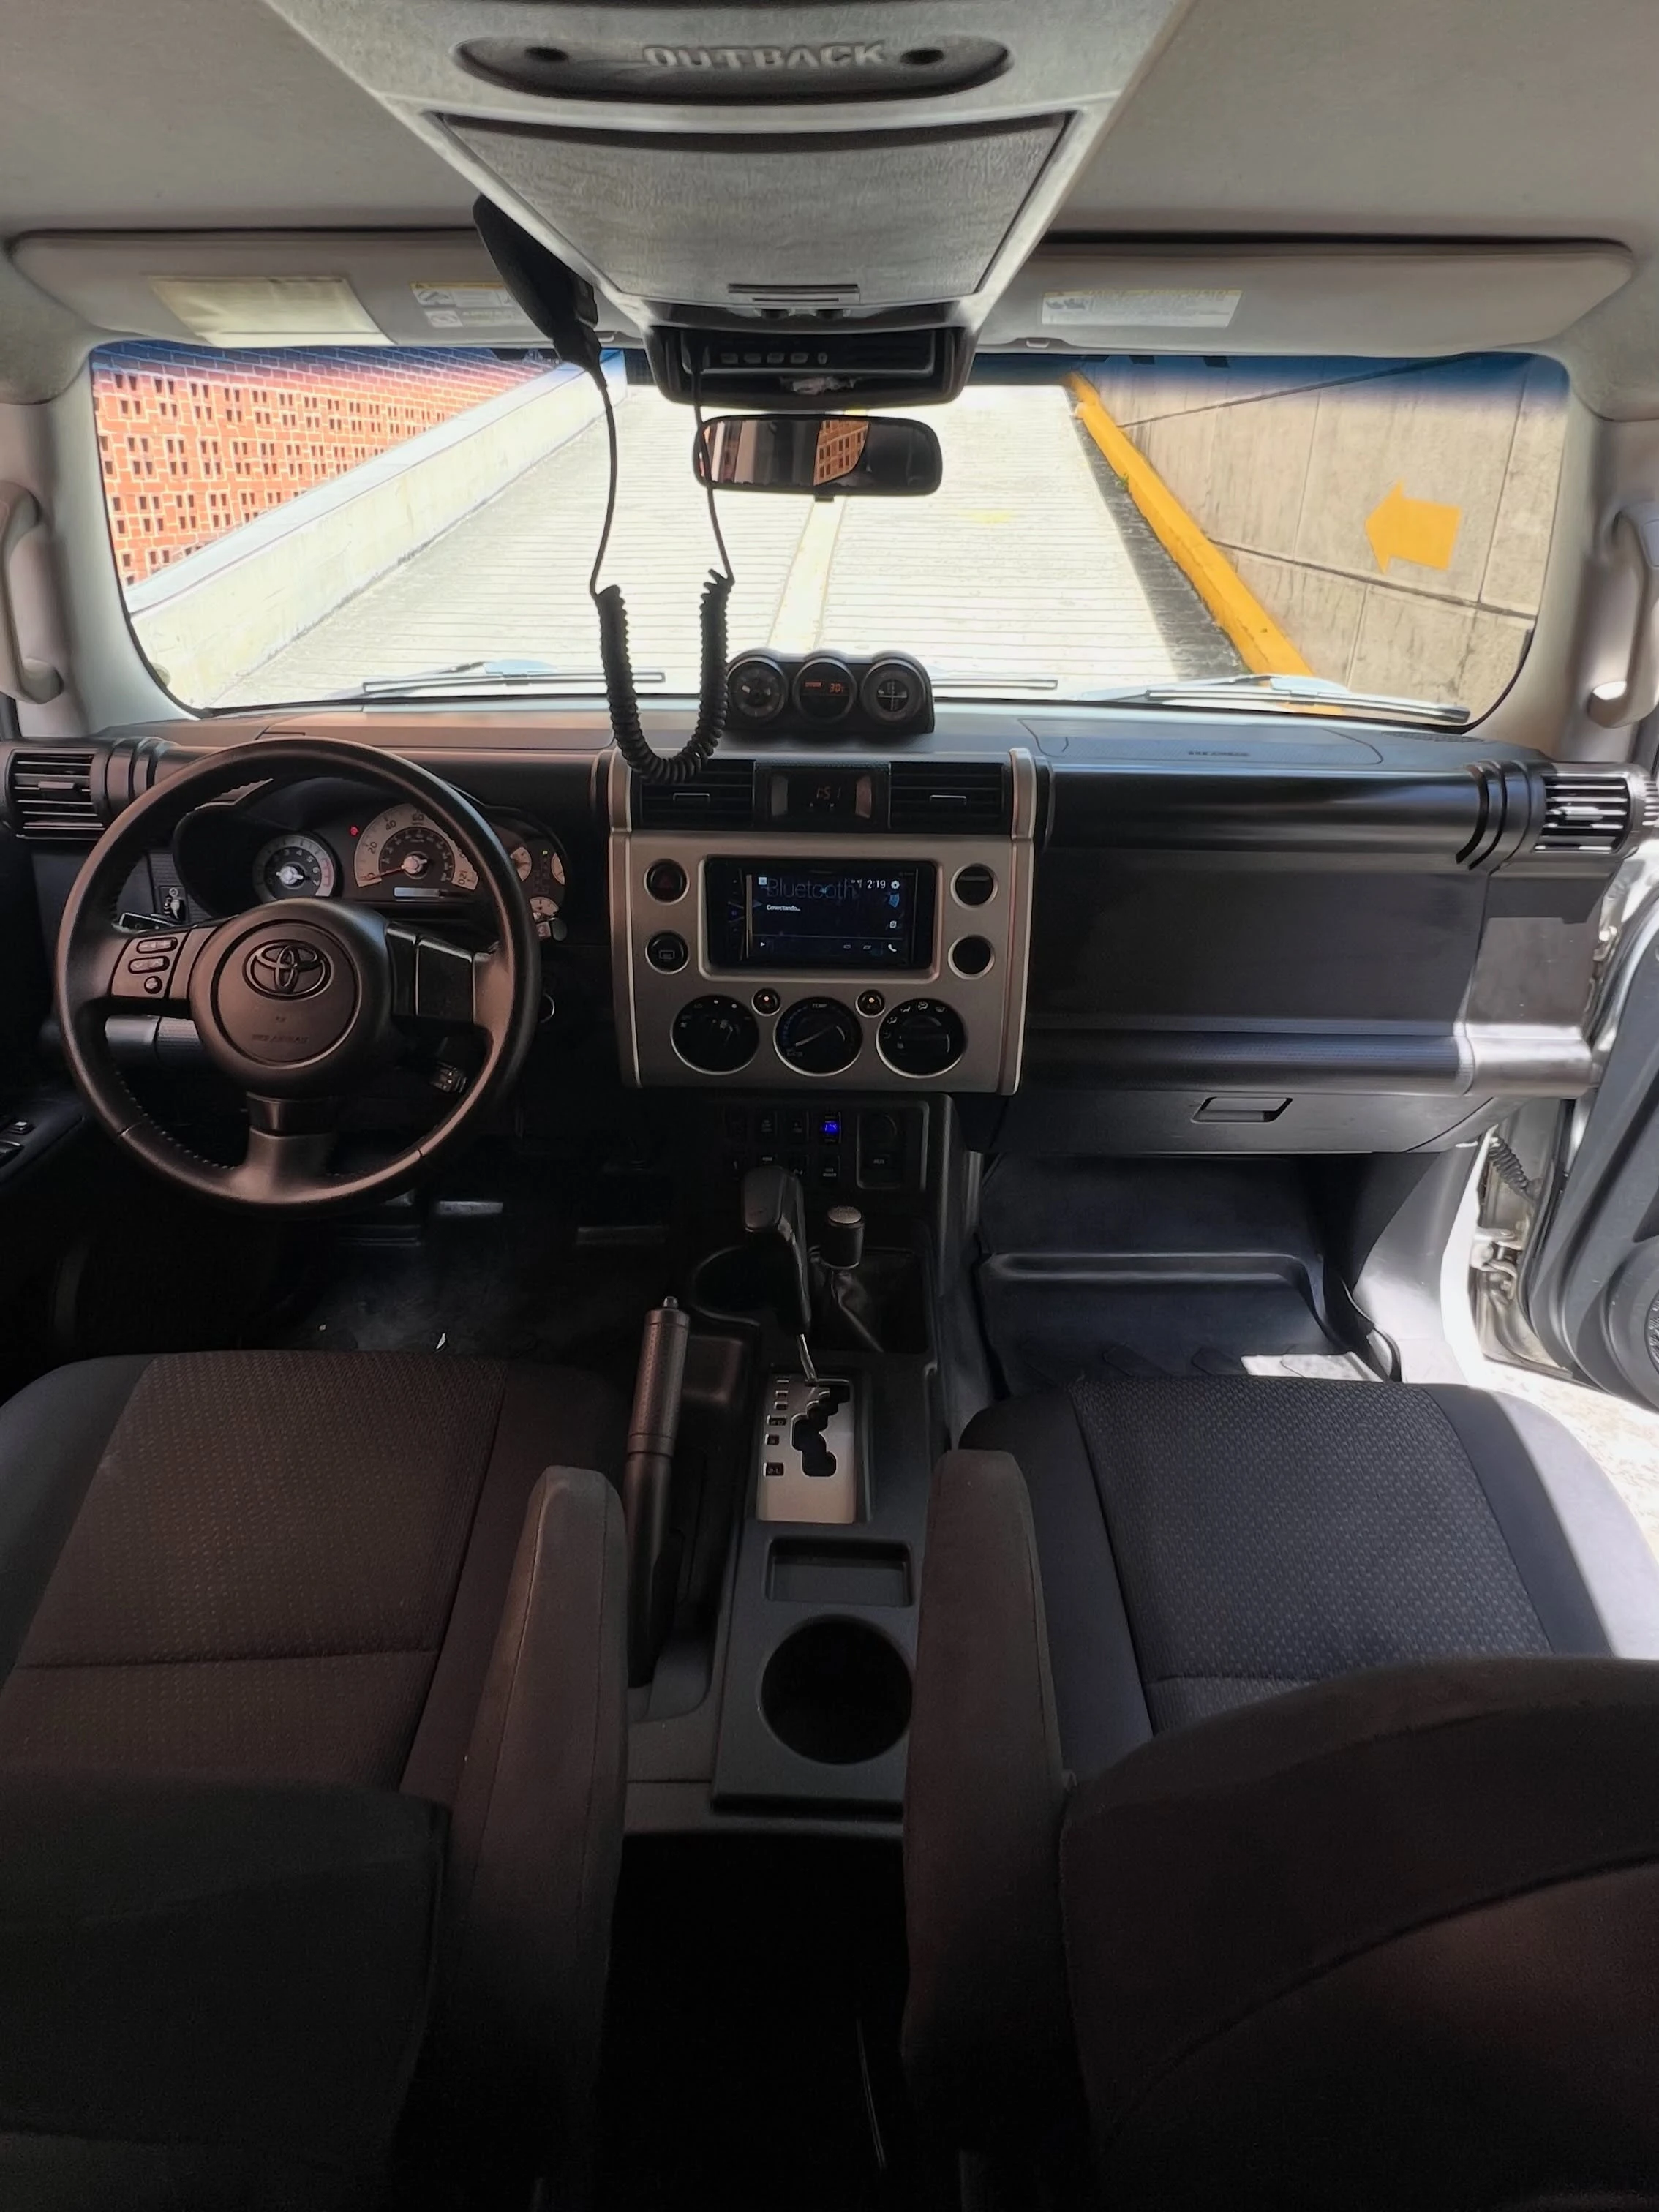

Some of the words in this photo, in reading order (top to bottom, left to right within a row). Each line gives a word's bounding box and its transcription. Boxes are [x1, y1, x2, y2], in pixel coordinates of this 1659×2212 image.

[643, 40, 883, 69] OUTBACK
[385, 819, 397, 831] 40
[368, 841, 378, 854] 20
[306, 854, 315, 863] 5
[458, 870, 468, 885] 120
[867, 879, 886, 889] 2:19
[767, 878, 854, 900] Bluetooth
